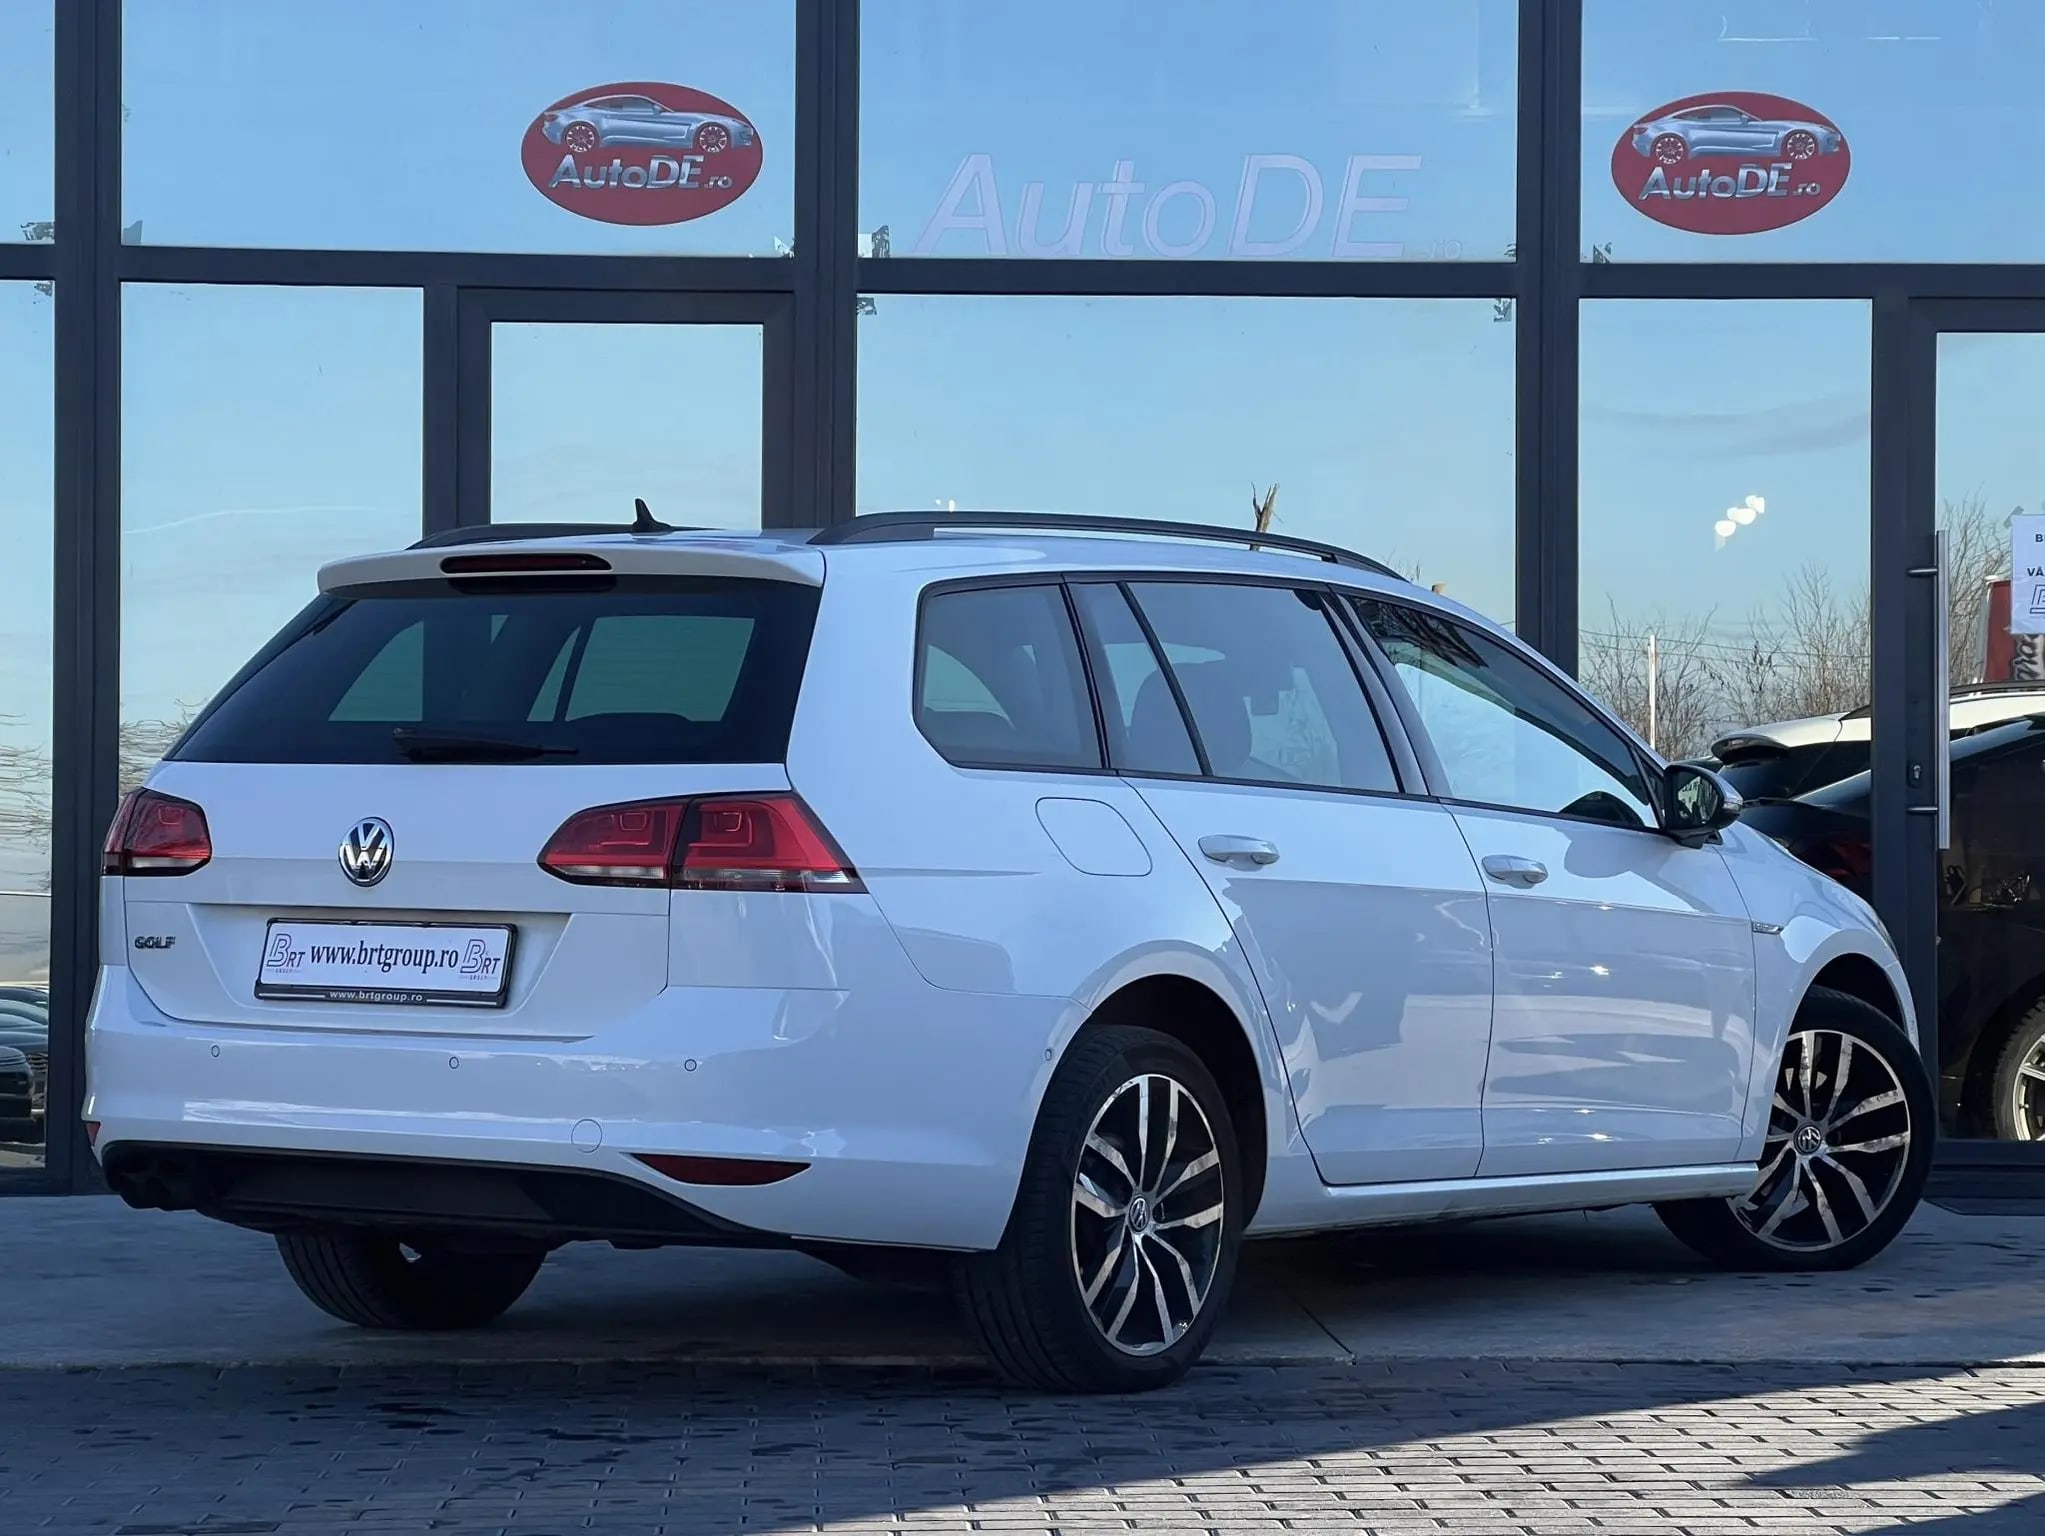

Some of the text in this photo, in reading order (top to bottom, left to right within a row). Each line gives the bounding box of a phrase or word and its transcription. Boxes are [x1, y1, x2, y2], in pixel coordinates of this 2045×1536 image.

[339, 818, 392, 885] VW
[134, 936, 176, 949] GOLF
[311, 940, 459, 974] www.brtgroup.ro
[329, 990, 423, 1003] www.brtgroup.ro
